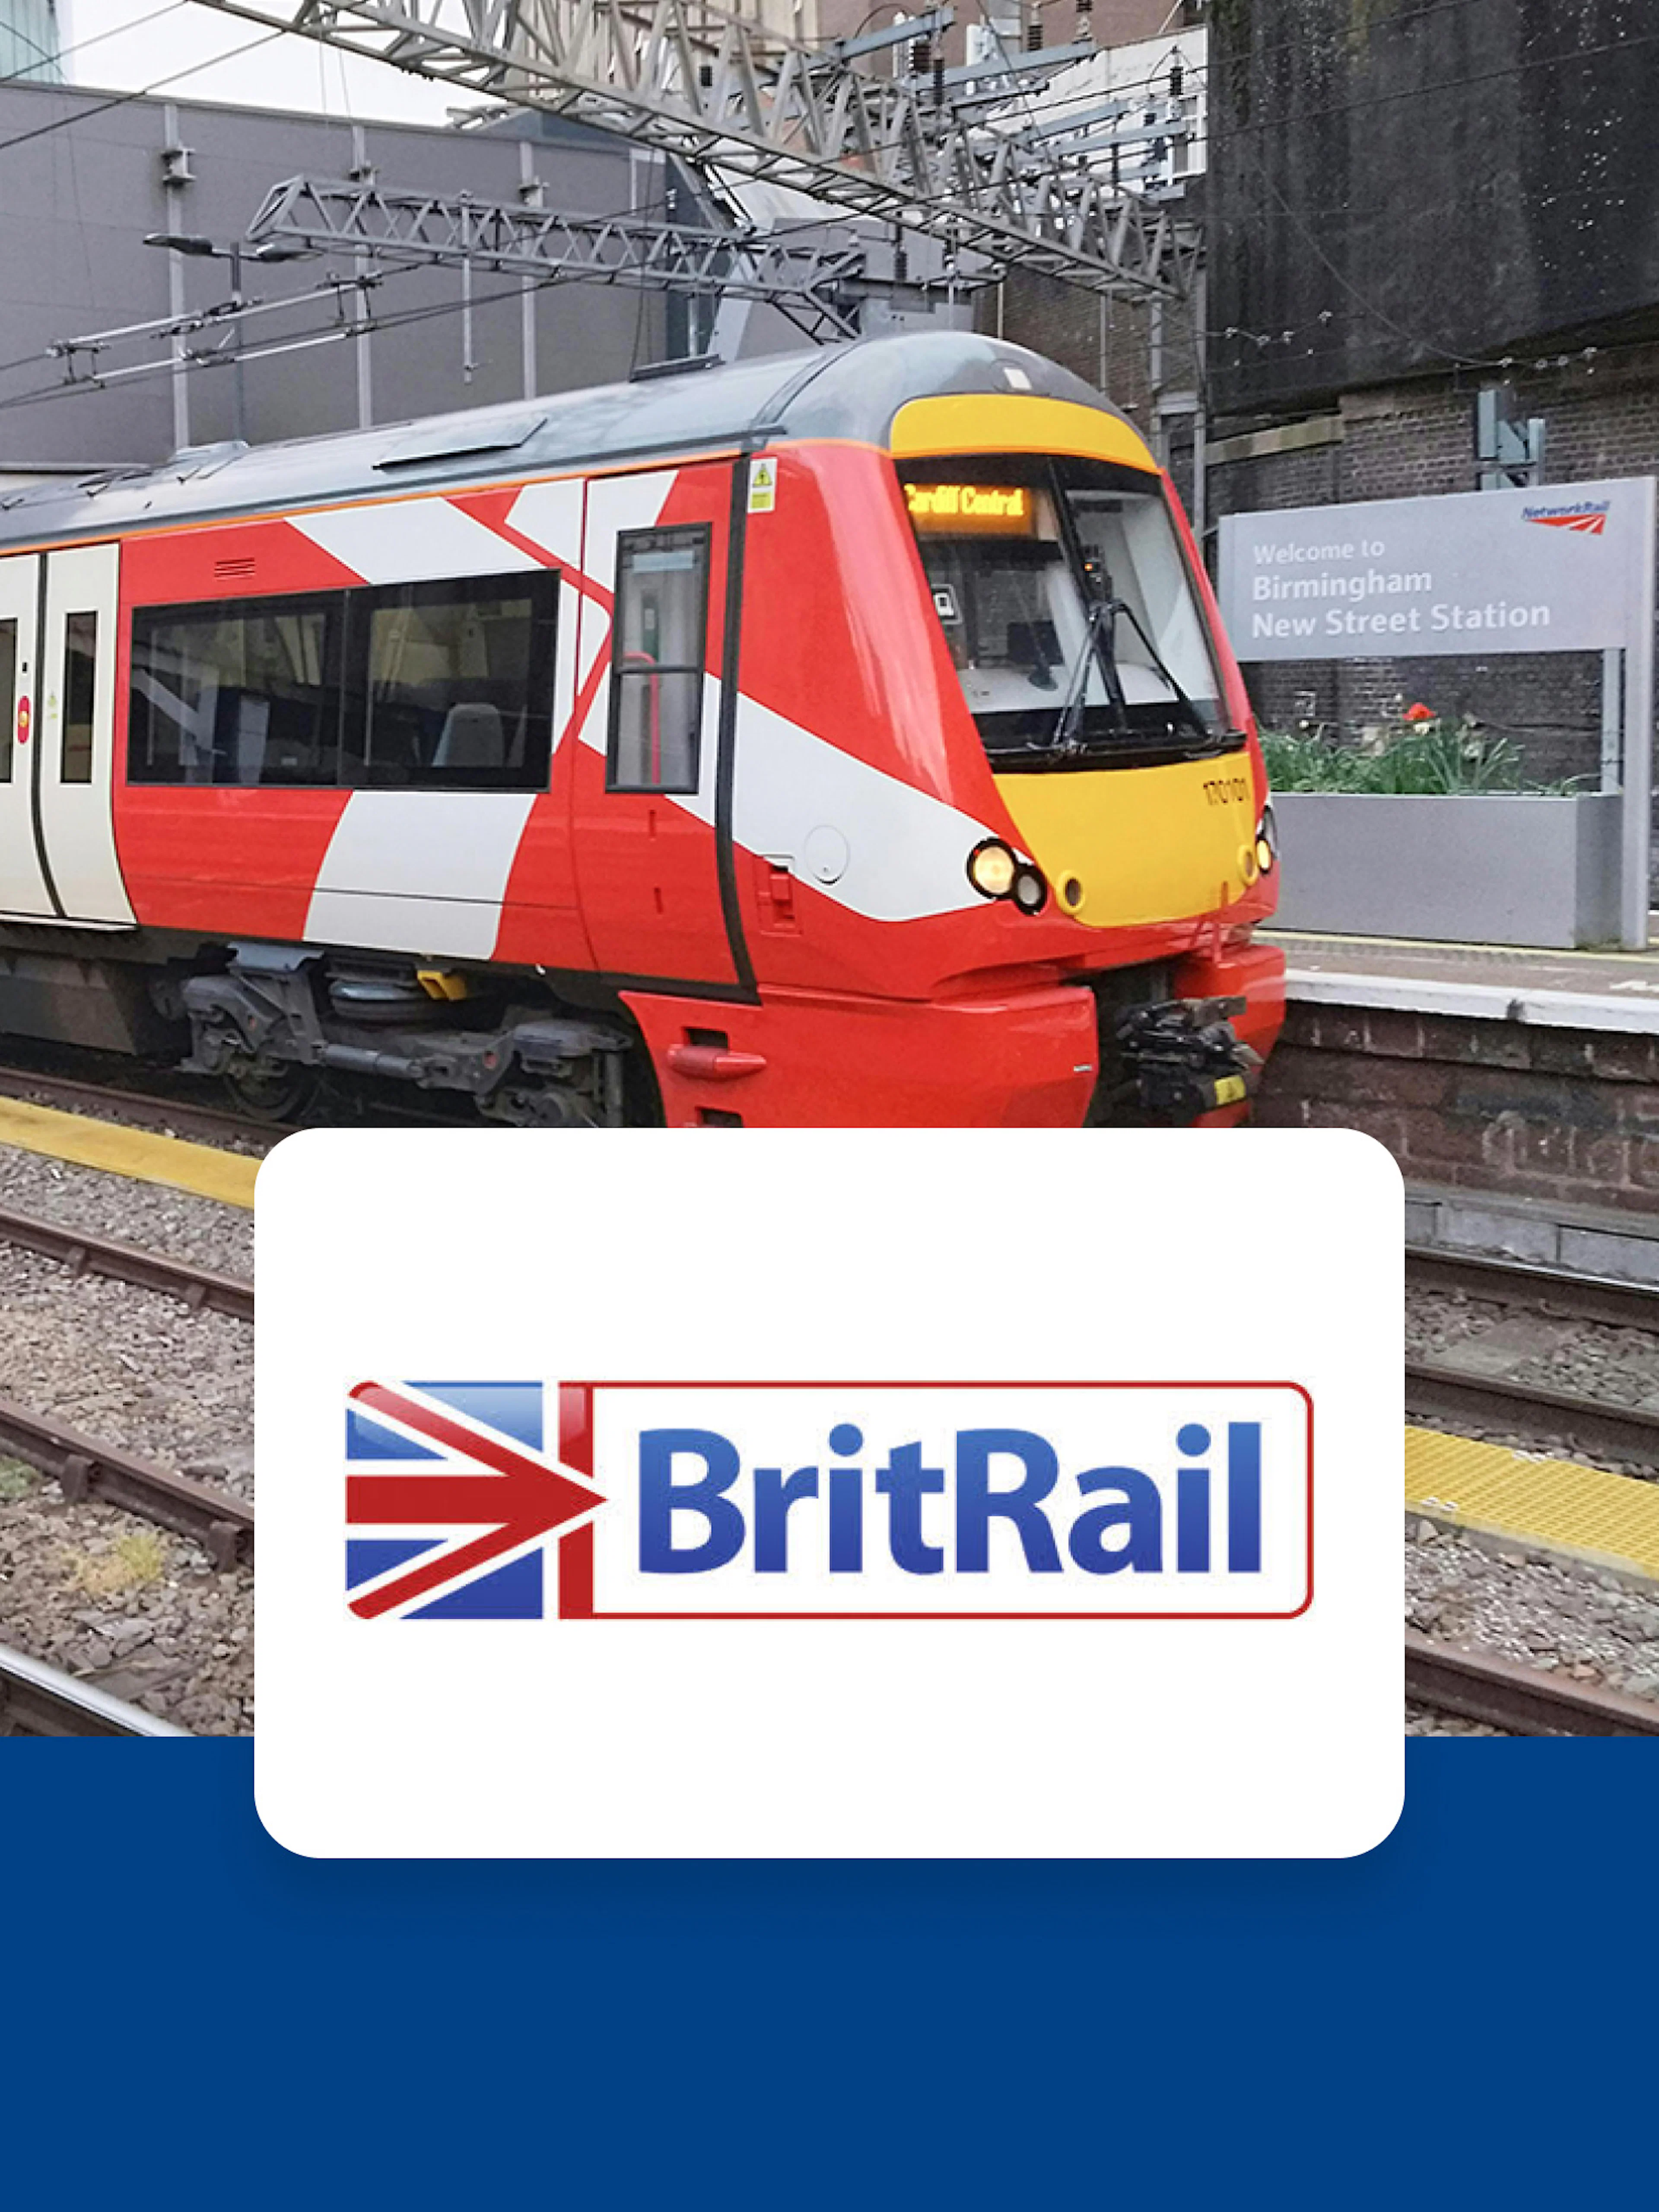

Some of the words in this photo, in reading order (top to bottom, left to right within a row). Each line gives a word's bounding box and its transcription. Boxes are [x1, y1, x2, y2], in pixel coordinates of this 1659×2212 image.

[962, 486, 1023, 515] Central
[1254, 542, 1354, 564] Welcome
[1362, 540, 1385, 558] to
[1254, 568, 1432, 602] Birmingham
[1254, 612, 1317, 638] New
[1325, 609, 1421, 635] Street
[1431, 601, 1550, 631] Station
